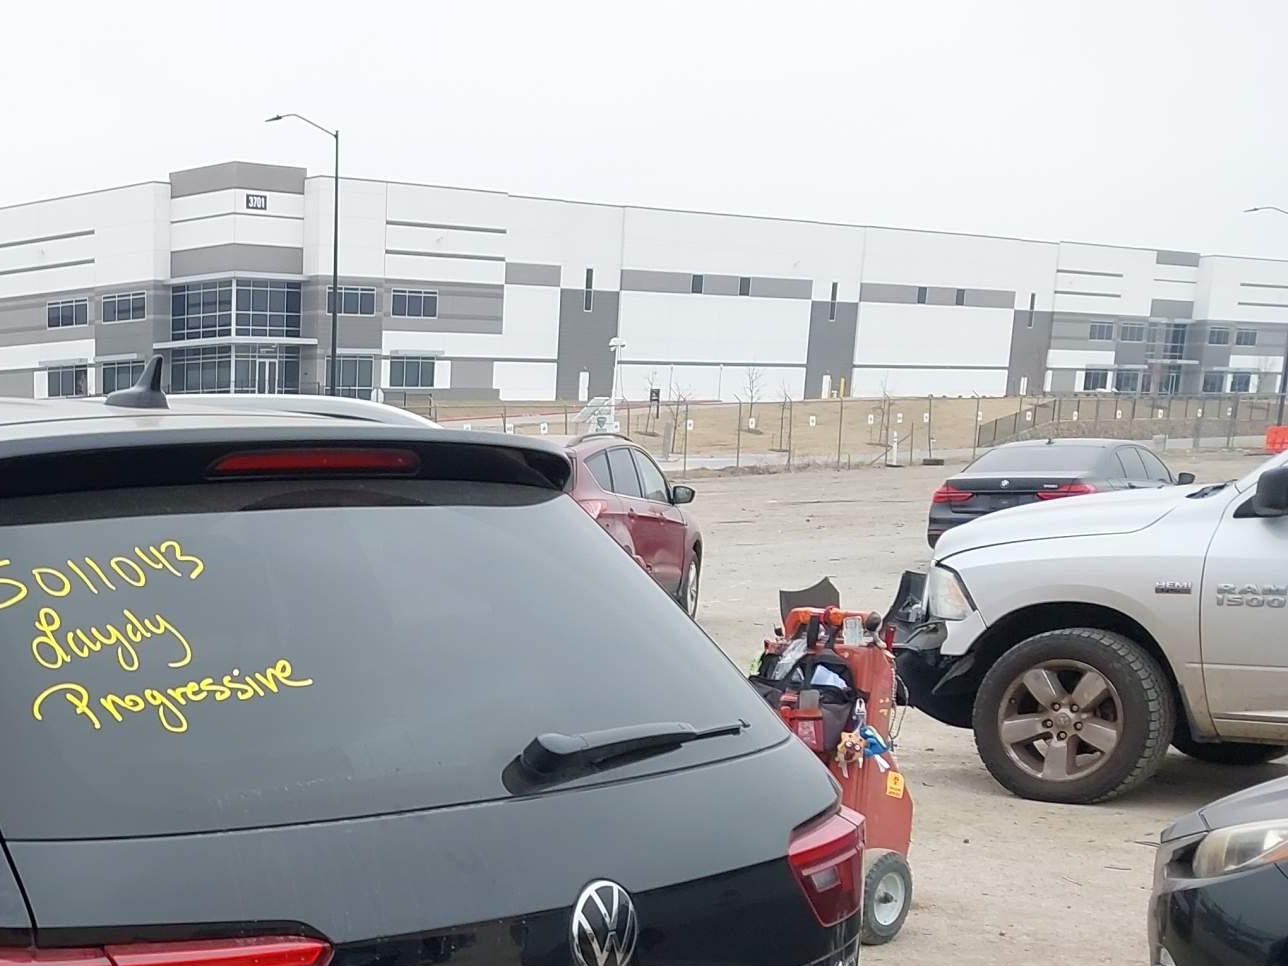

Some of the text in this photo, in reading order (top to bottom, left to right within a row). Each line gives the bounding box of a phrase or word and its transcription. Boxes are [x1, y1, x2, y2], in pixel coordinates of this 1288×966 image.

[247, 195, 265, 208] 3701
[1216, 583, 1288, 596] RAM
[1216, 594, 1287, 608] 1500
[32, 658, 313, 733] Progressive
